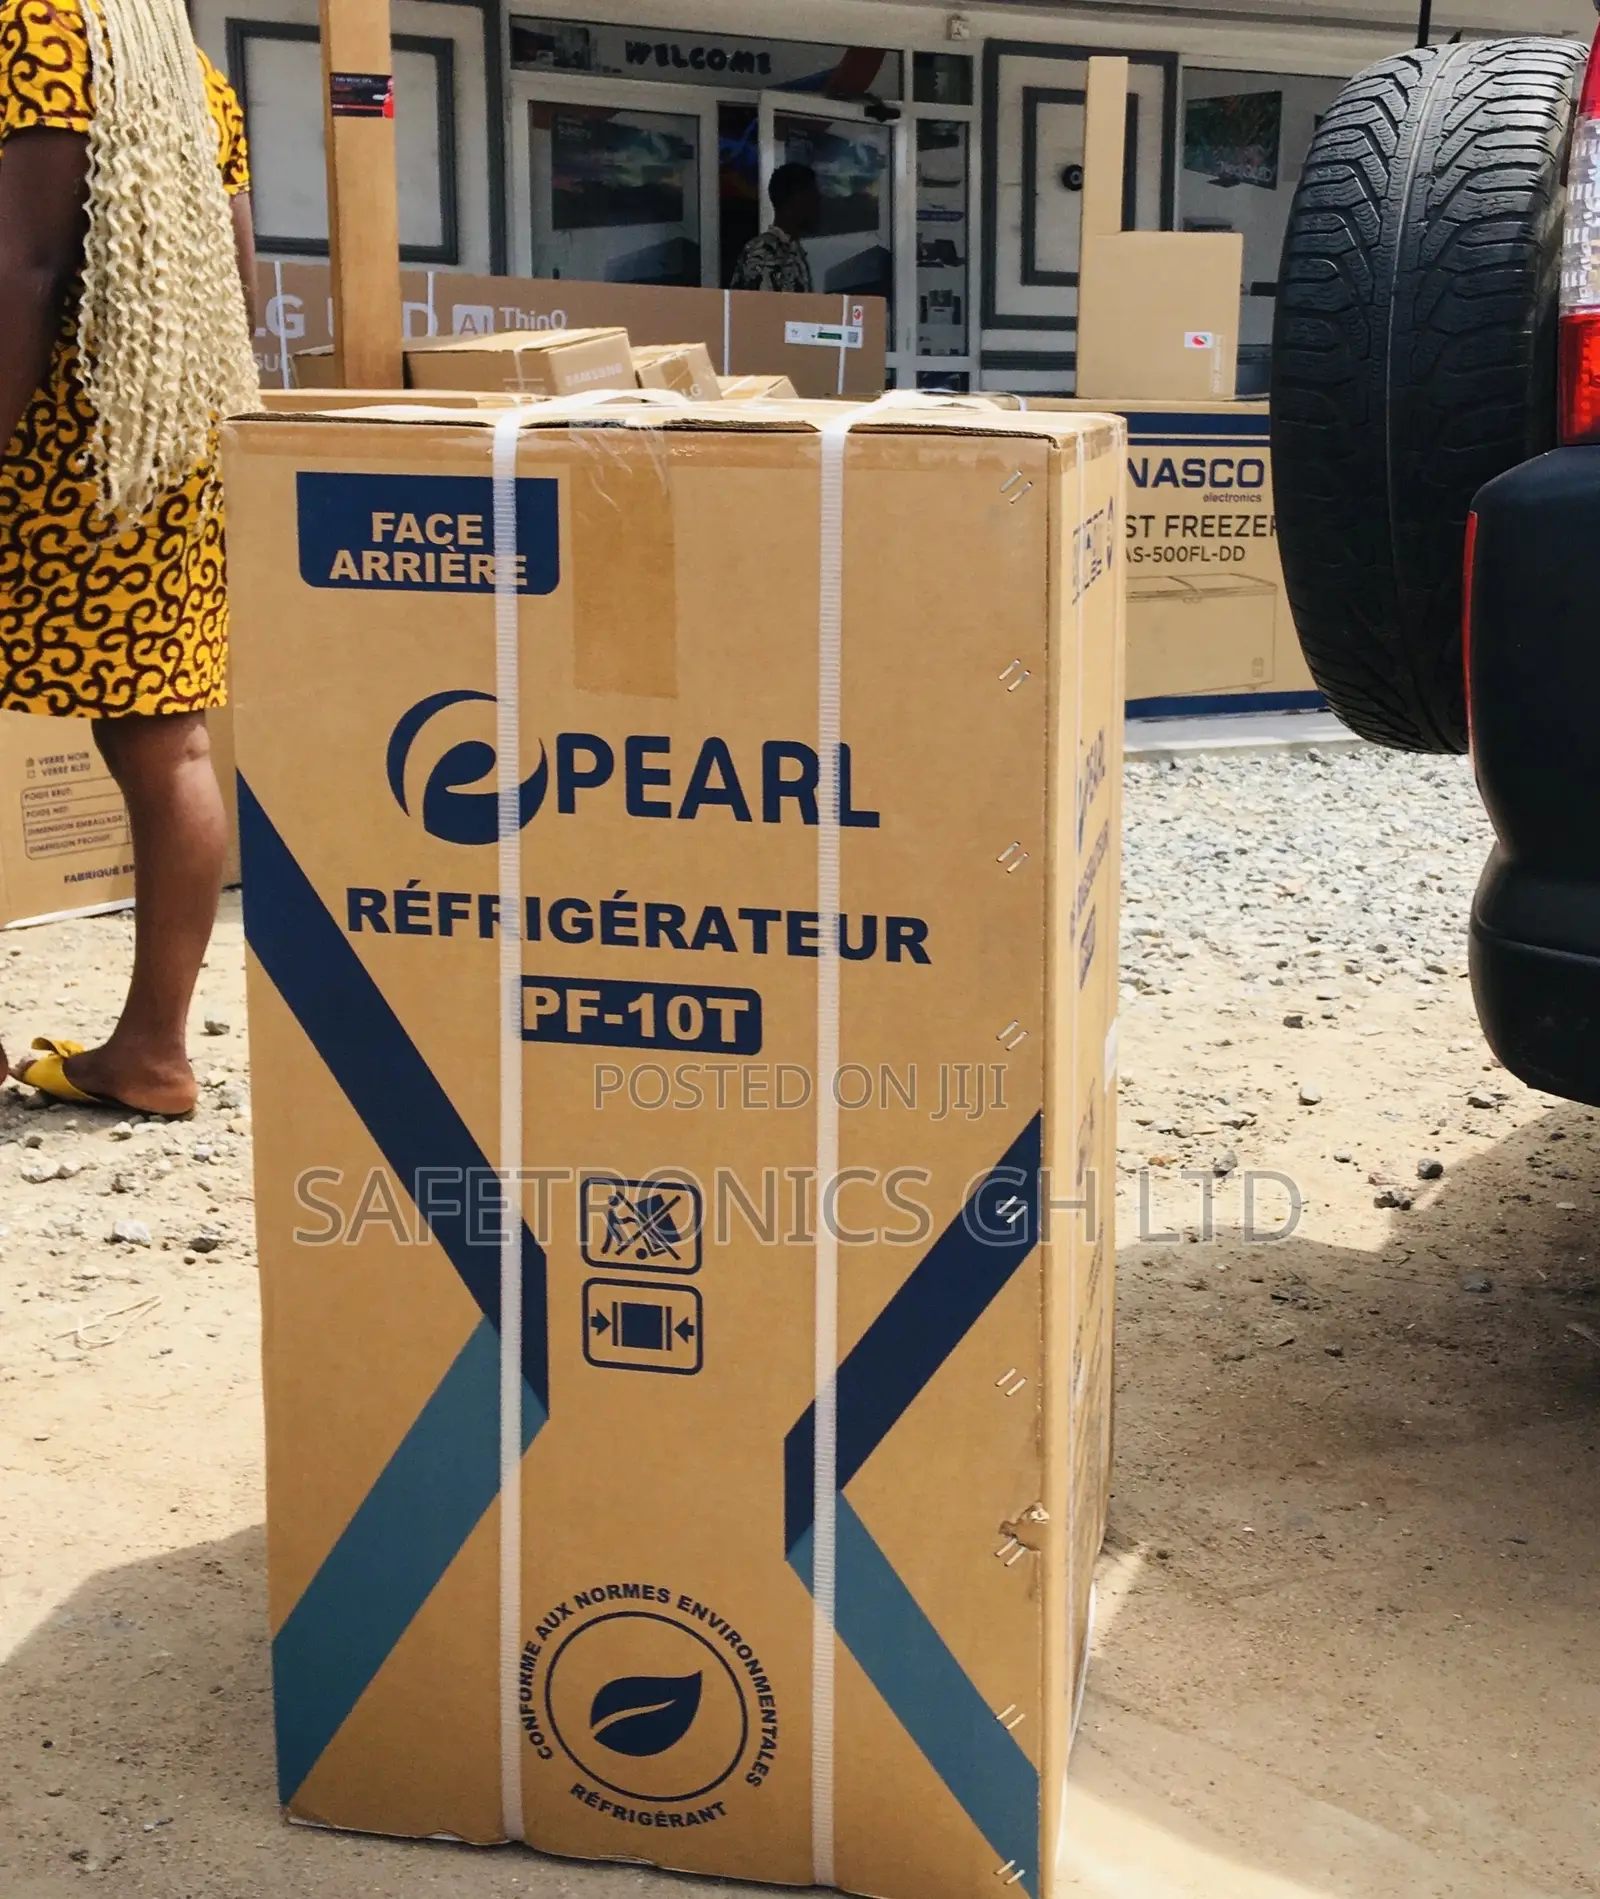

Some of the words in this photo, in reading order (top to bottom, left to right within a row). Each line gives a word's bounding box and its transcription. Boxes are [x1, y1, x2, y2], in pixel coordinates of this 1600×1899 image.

[625, 40, 772, 75] WELCOME
[254, 294, 305, 339] G
[565, 362, 623, 388] SAMSUNG
[1127, 457, 1265, 488] NASCO
[1202, 492, 1262, 504] electronics
[372, 511, 484, 546] FACE
[1126, 515, 1156, 538] ST
[329, 547, 528, 586] ARRIÈRE
[556, 732, 880, 828] PEARL
[345, 879, 932, 964] RÉFRIGÉRATEUR
[522, 986, 750, 1043] PF-10T
[573, 1583, 672, 1609] NORMES
[535, 1602, 575, 1641] AUX
[518, 1640, 553, 1760] CONFORME
[676, 1594, 780, 1788] ENVIRONMENTALES
[569, 1782, 728, 1828] RÉFRIGÉRANT
